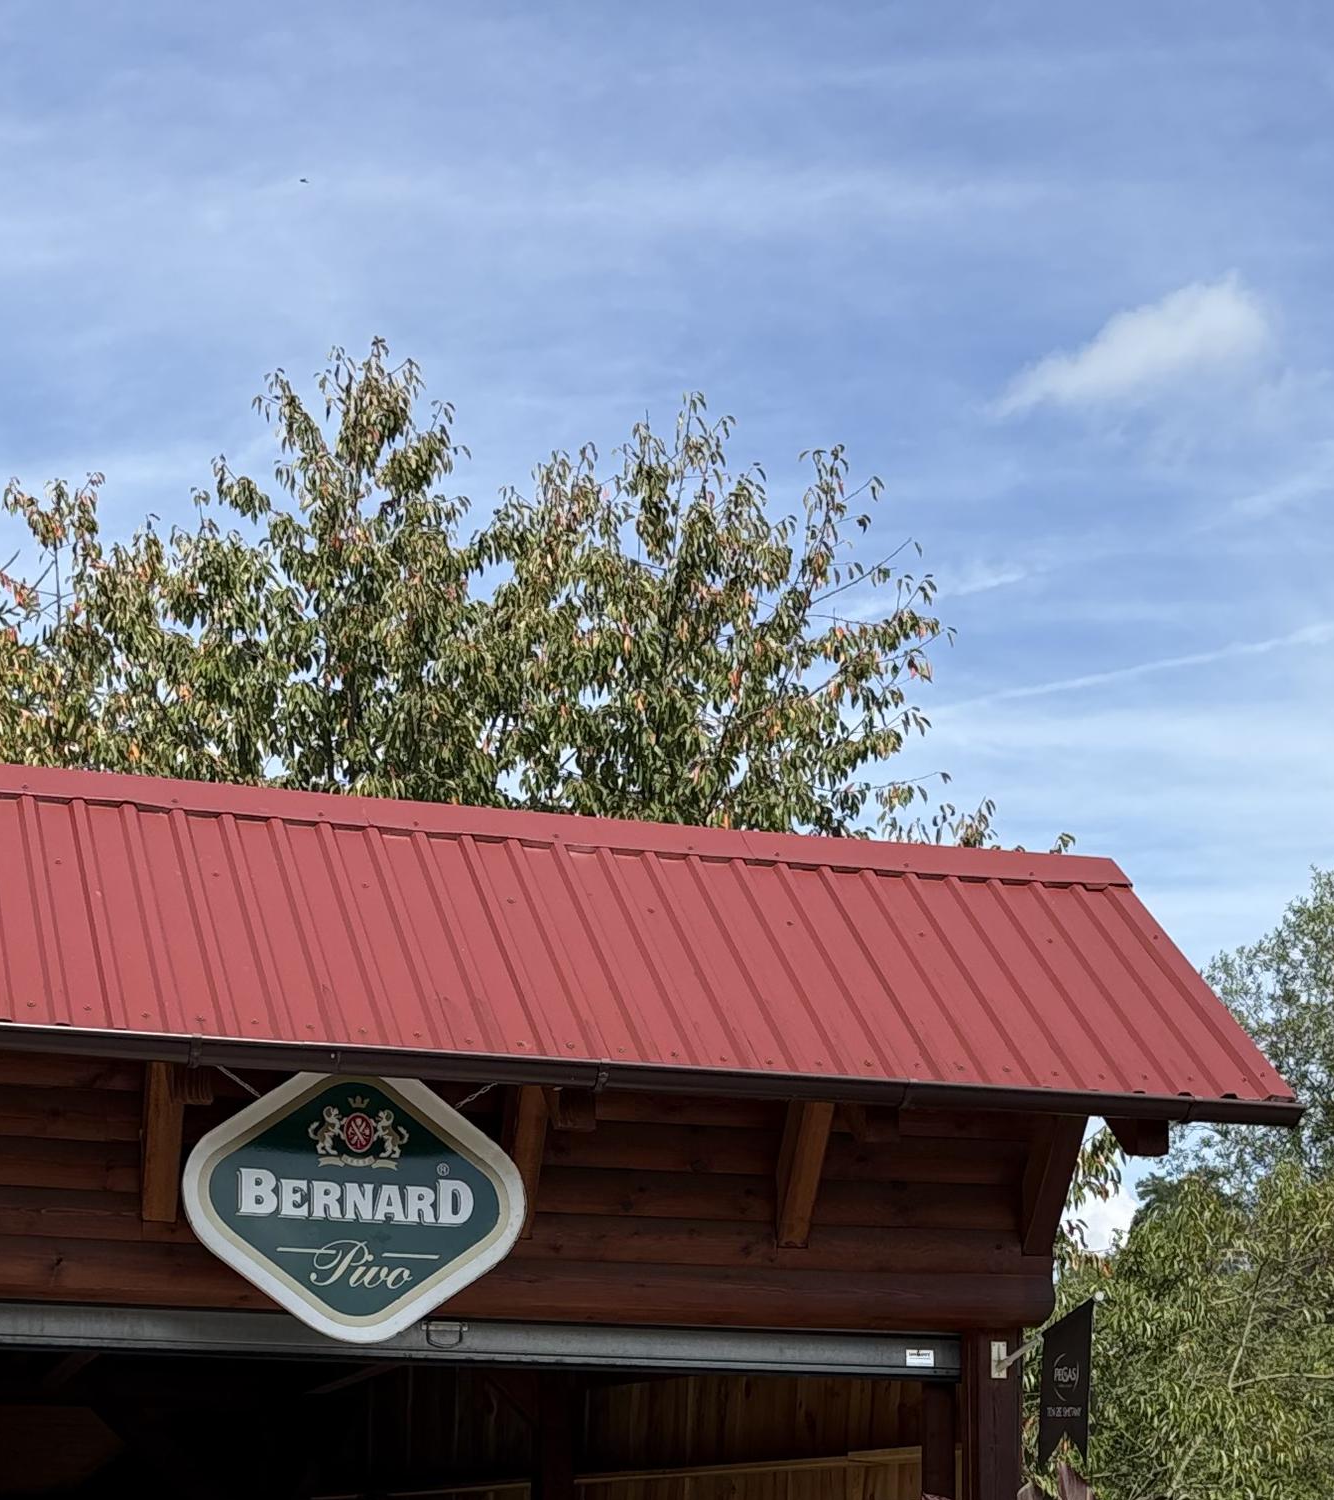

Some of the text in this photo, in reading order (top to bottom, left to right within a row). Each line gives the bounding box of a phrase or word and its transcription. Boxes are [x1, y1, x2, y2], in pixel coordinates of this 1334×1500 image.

[236, 1167, 474, 1227] BERNARD
[310, 1239, 413, 1289] Pivo
[1053, 1366, 1077, 1383] PEGAS
